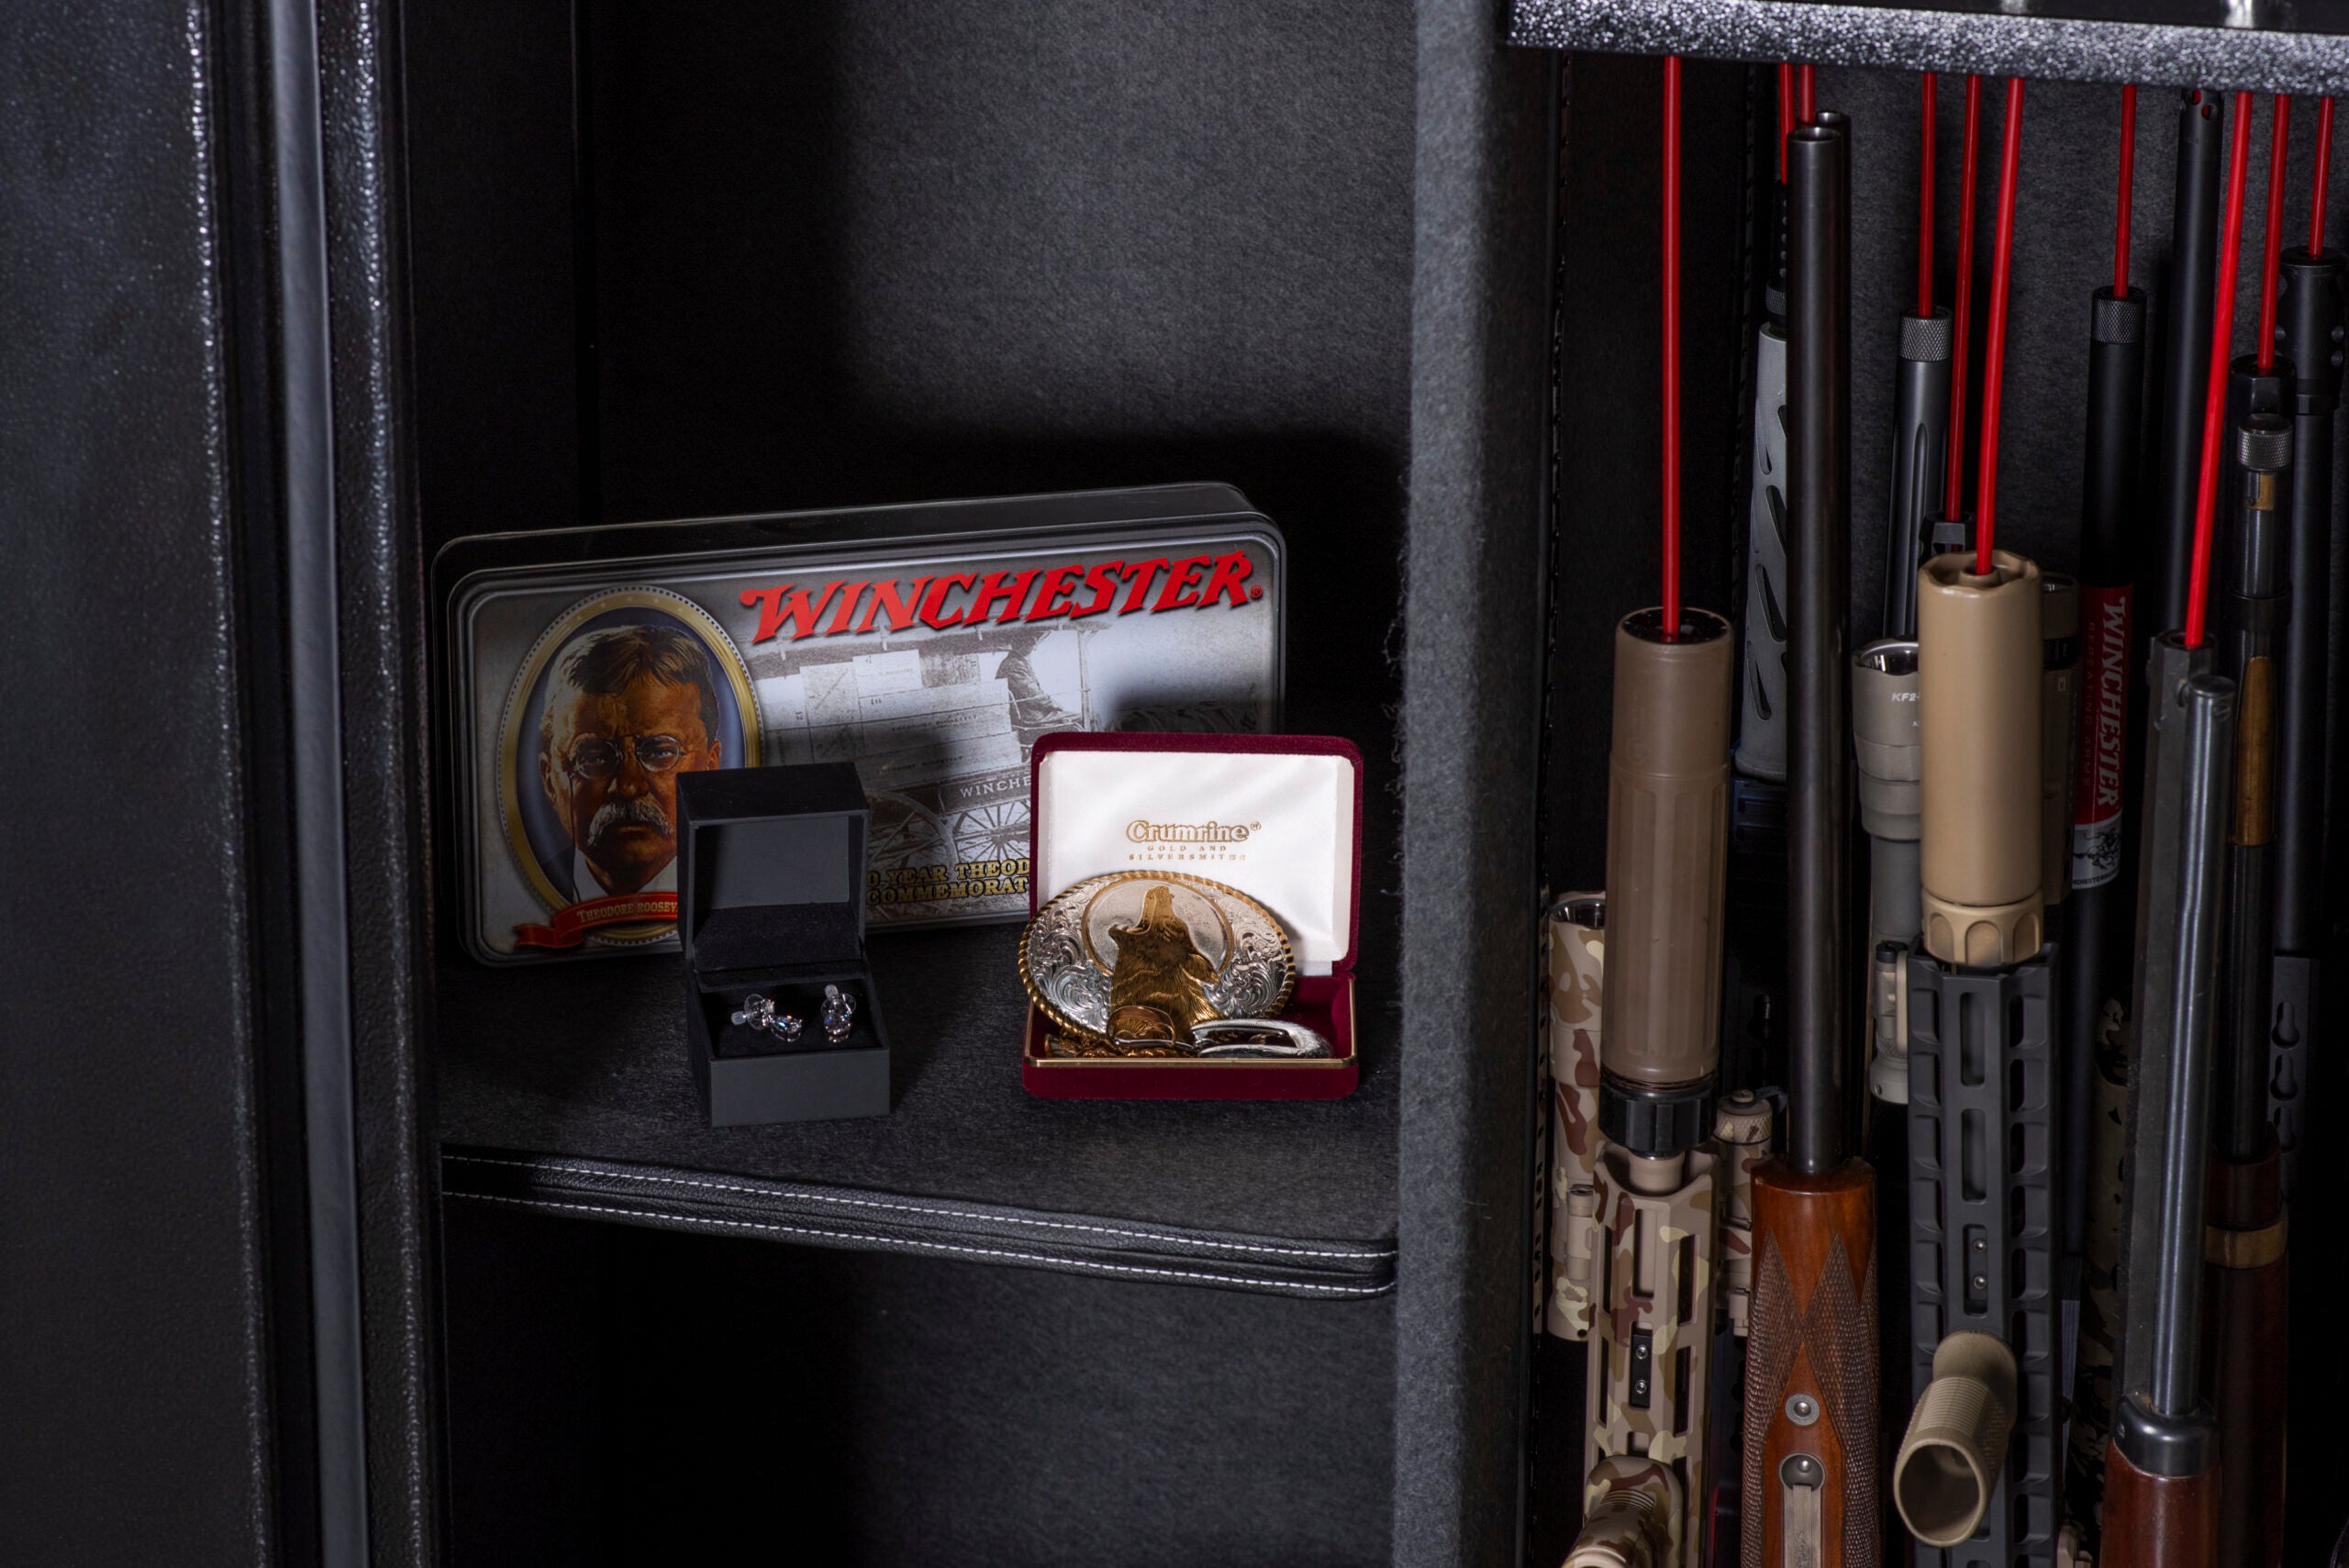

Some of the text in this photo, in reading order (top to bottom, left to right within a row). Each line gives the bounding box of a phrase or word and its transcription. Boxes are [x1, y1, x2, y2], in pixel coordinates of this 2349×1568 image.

[740, 550, 1252, 642] WINCHESTER
[2082, 621, 2095, 787] REPEATING ARMS
[2097, 596, 2127, 806] WINCHESTER
[866, 876, 1029, 906] COMMEMORAT
[887, 865, 948, 885] YEAR
[955, 858, 1030, 880] THEOD
[576, 902, 634, 923] THEODORE
